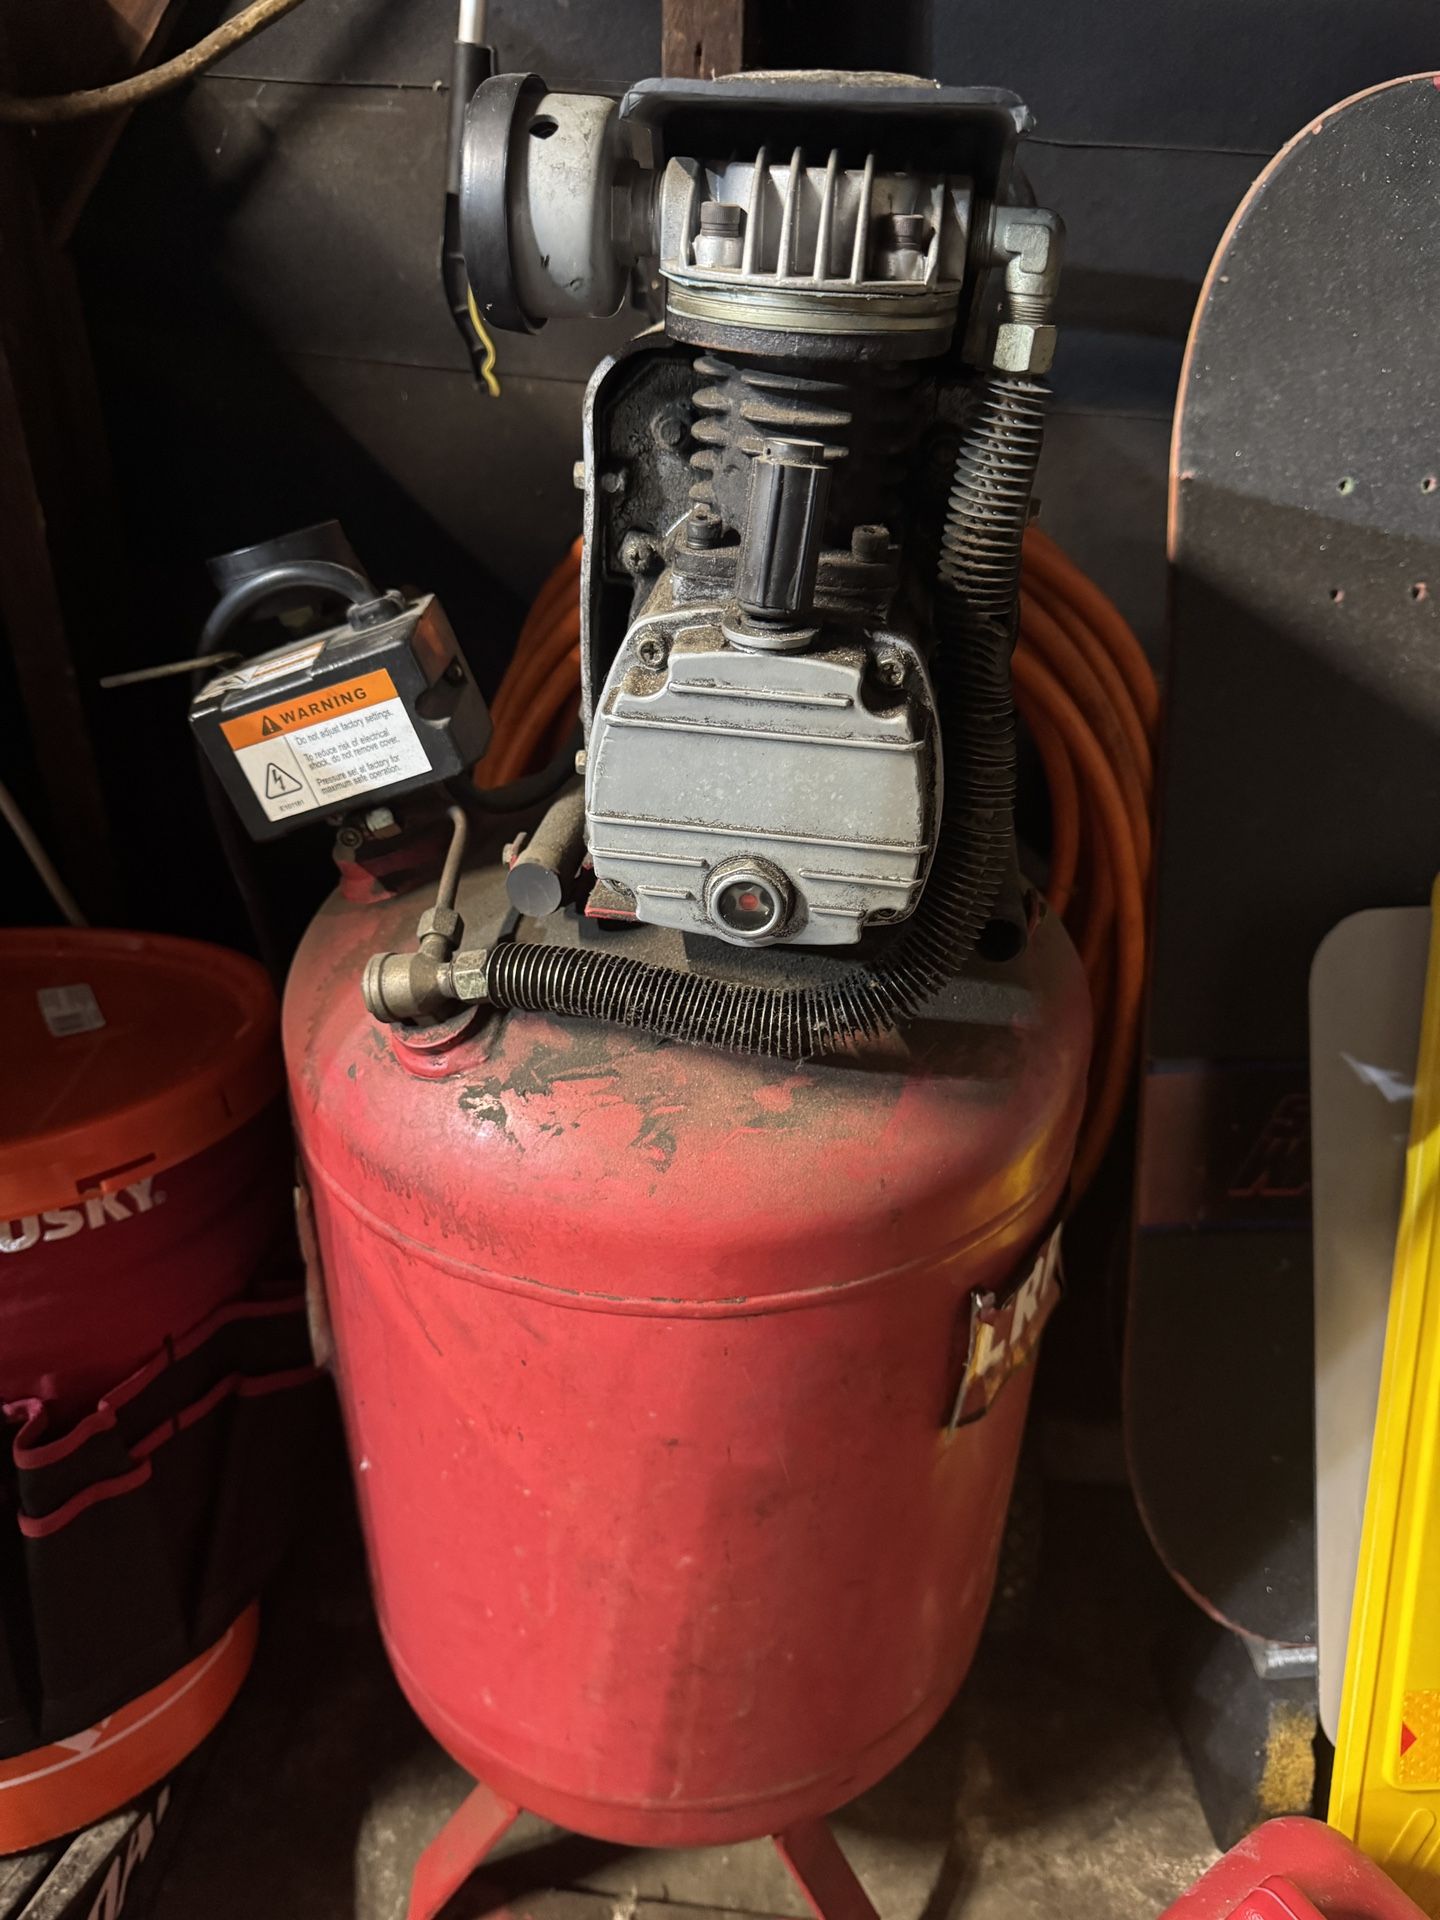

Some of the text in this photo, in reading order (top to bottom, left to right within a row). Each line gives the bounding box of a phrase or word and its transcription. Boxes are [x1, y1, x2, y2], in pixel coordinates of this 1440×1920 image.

[279, 687, 368, 724] WARNING
[295, 735, 308, 746] Do
[308, 731, 319, 741] not
[320, 724, 341, 739] adjust
[340, 718, 365, 732] factory
[304, 728, 390, 762] To reduce risk of electrical
[308, 736, 400, 771] shock, do not remove cover.
[316, 754, 400, 786] Pressure set at factory for
[321, 765, 401, 795] maximum safe operation.
